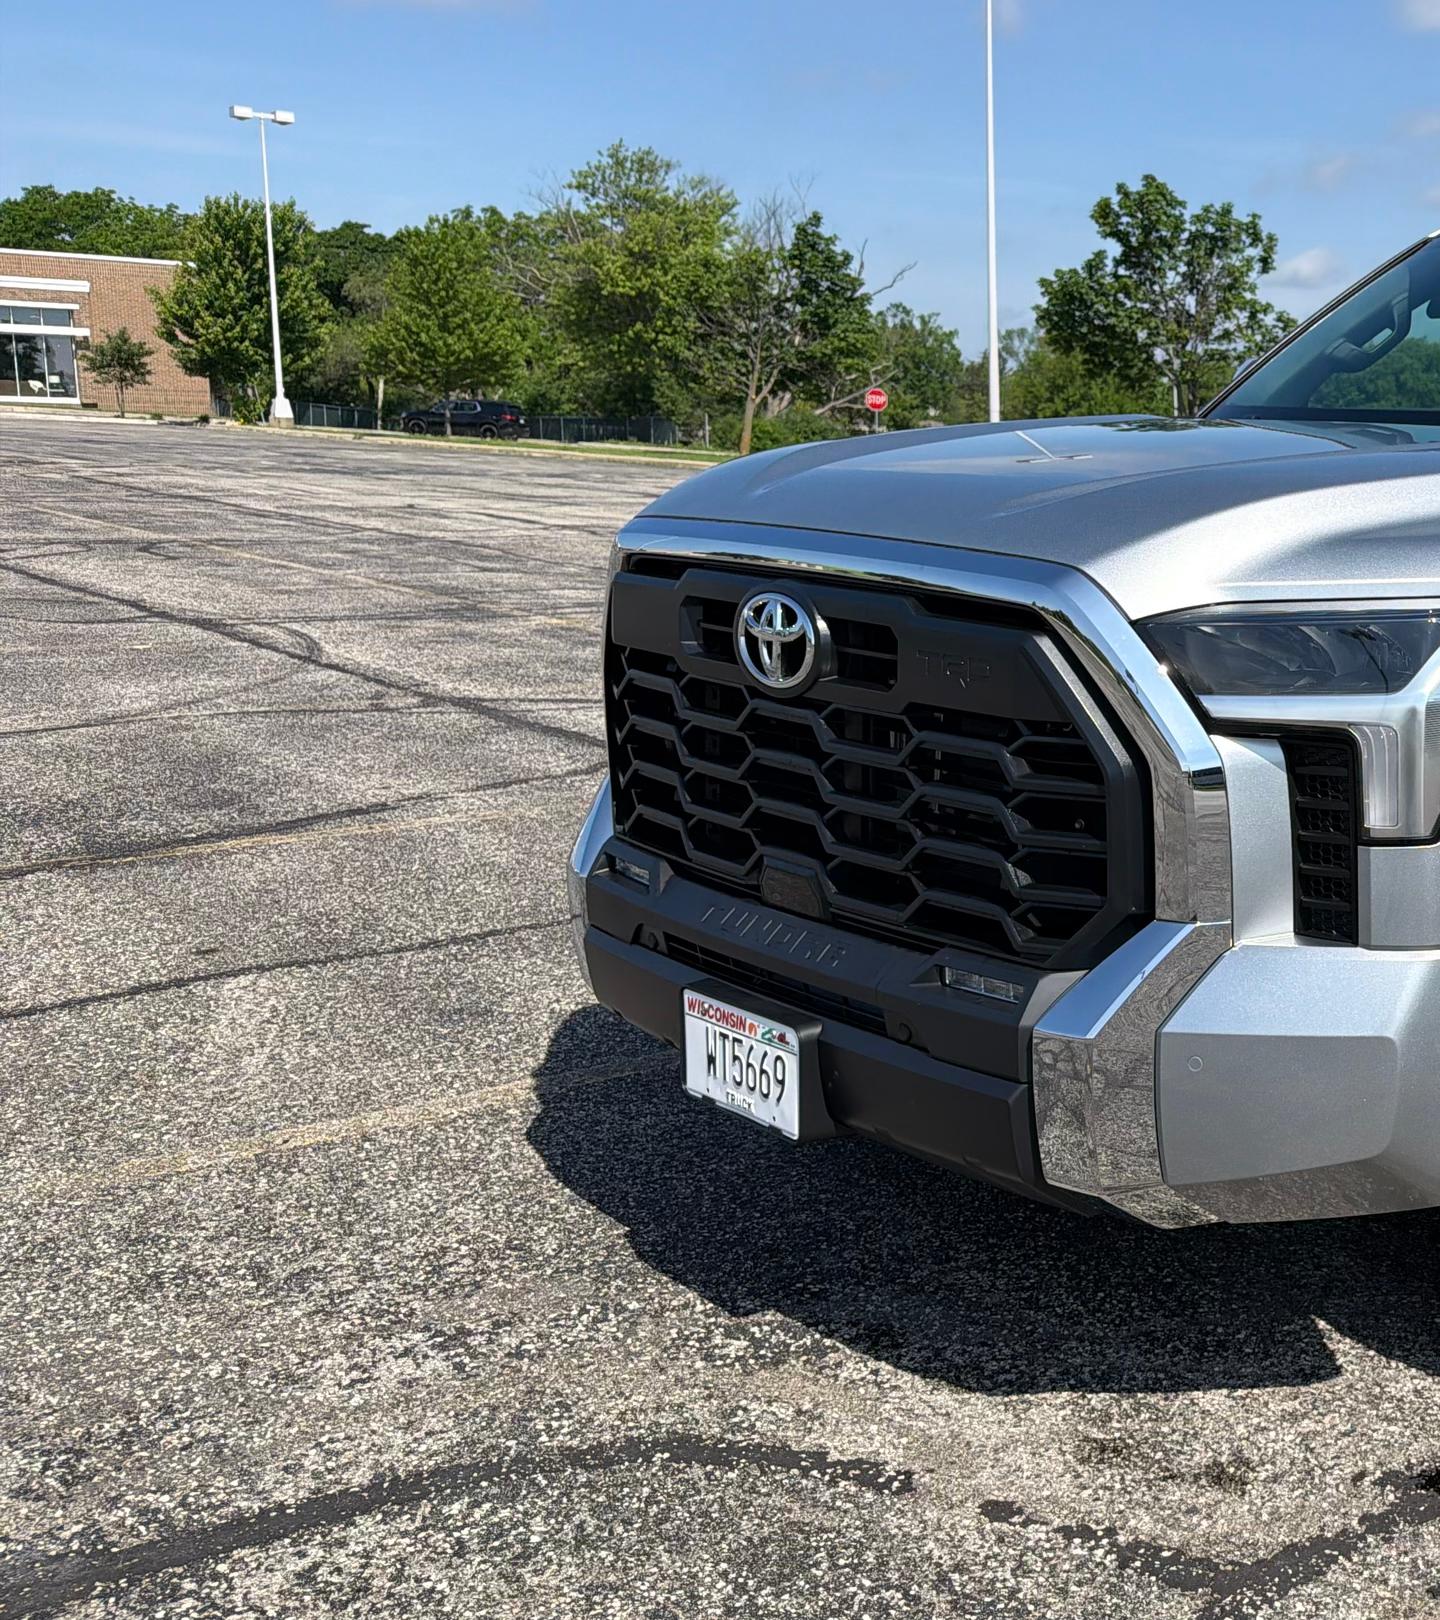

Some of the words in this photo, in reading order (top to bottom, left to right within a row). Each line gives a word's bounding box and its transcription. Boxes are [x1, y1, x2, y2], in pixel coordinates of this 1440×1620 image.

[868, 394, 886, 405] STOP
[687, 996, 747, 1034] WISCONSIN
[705, 1026, 787, 1107] WT5669
